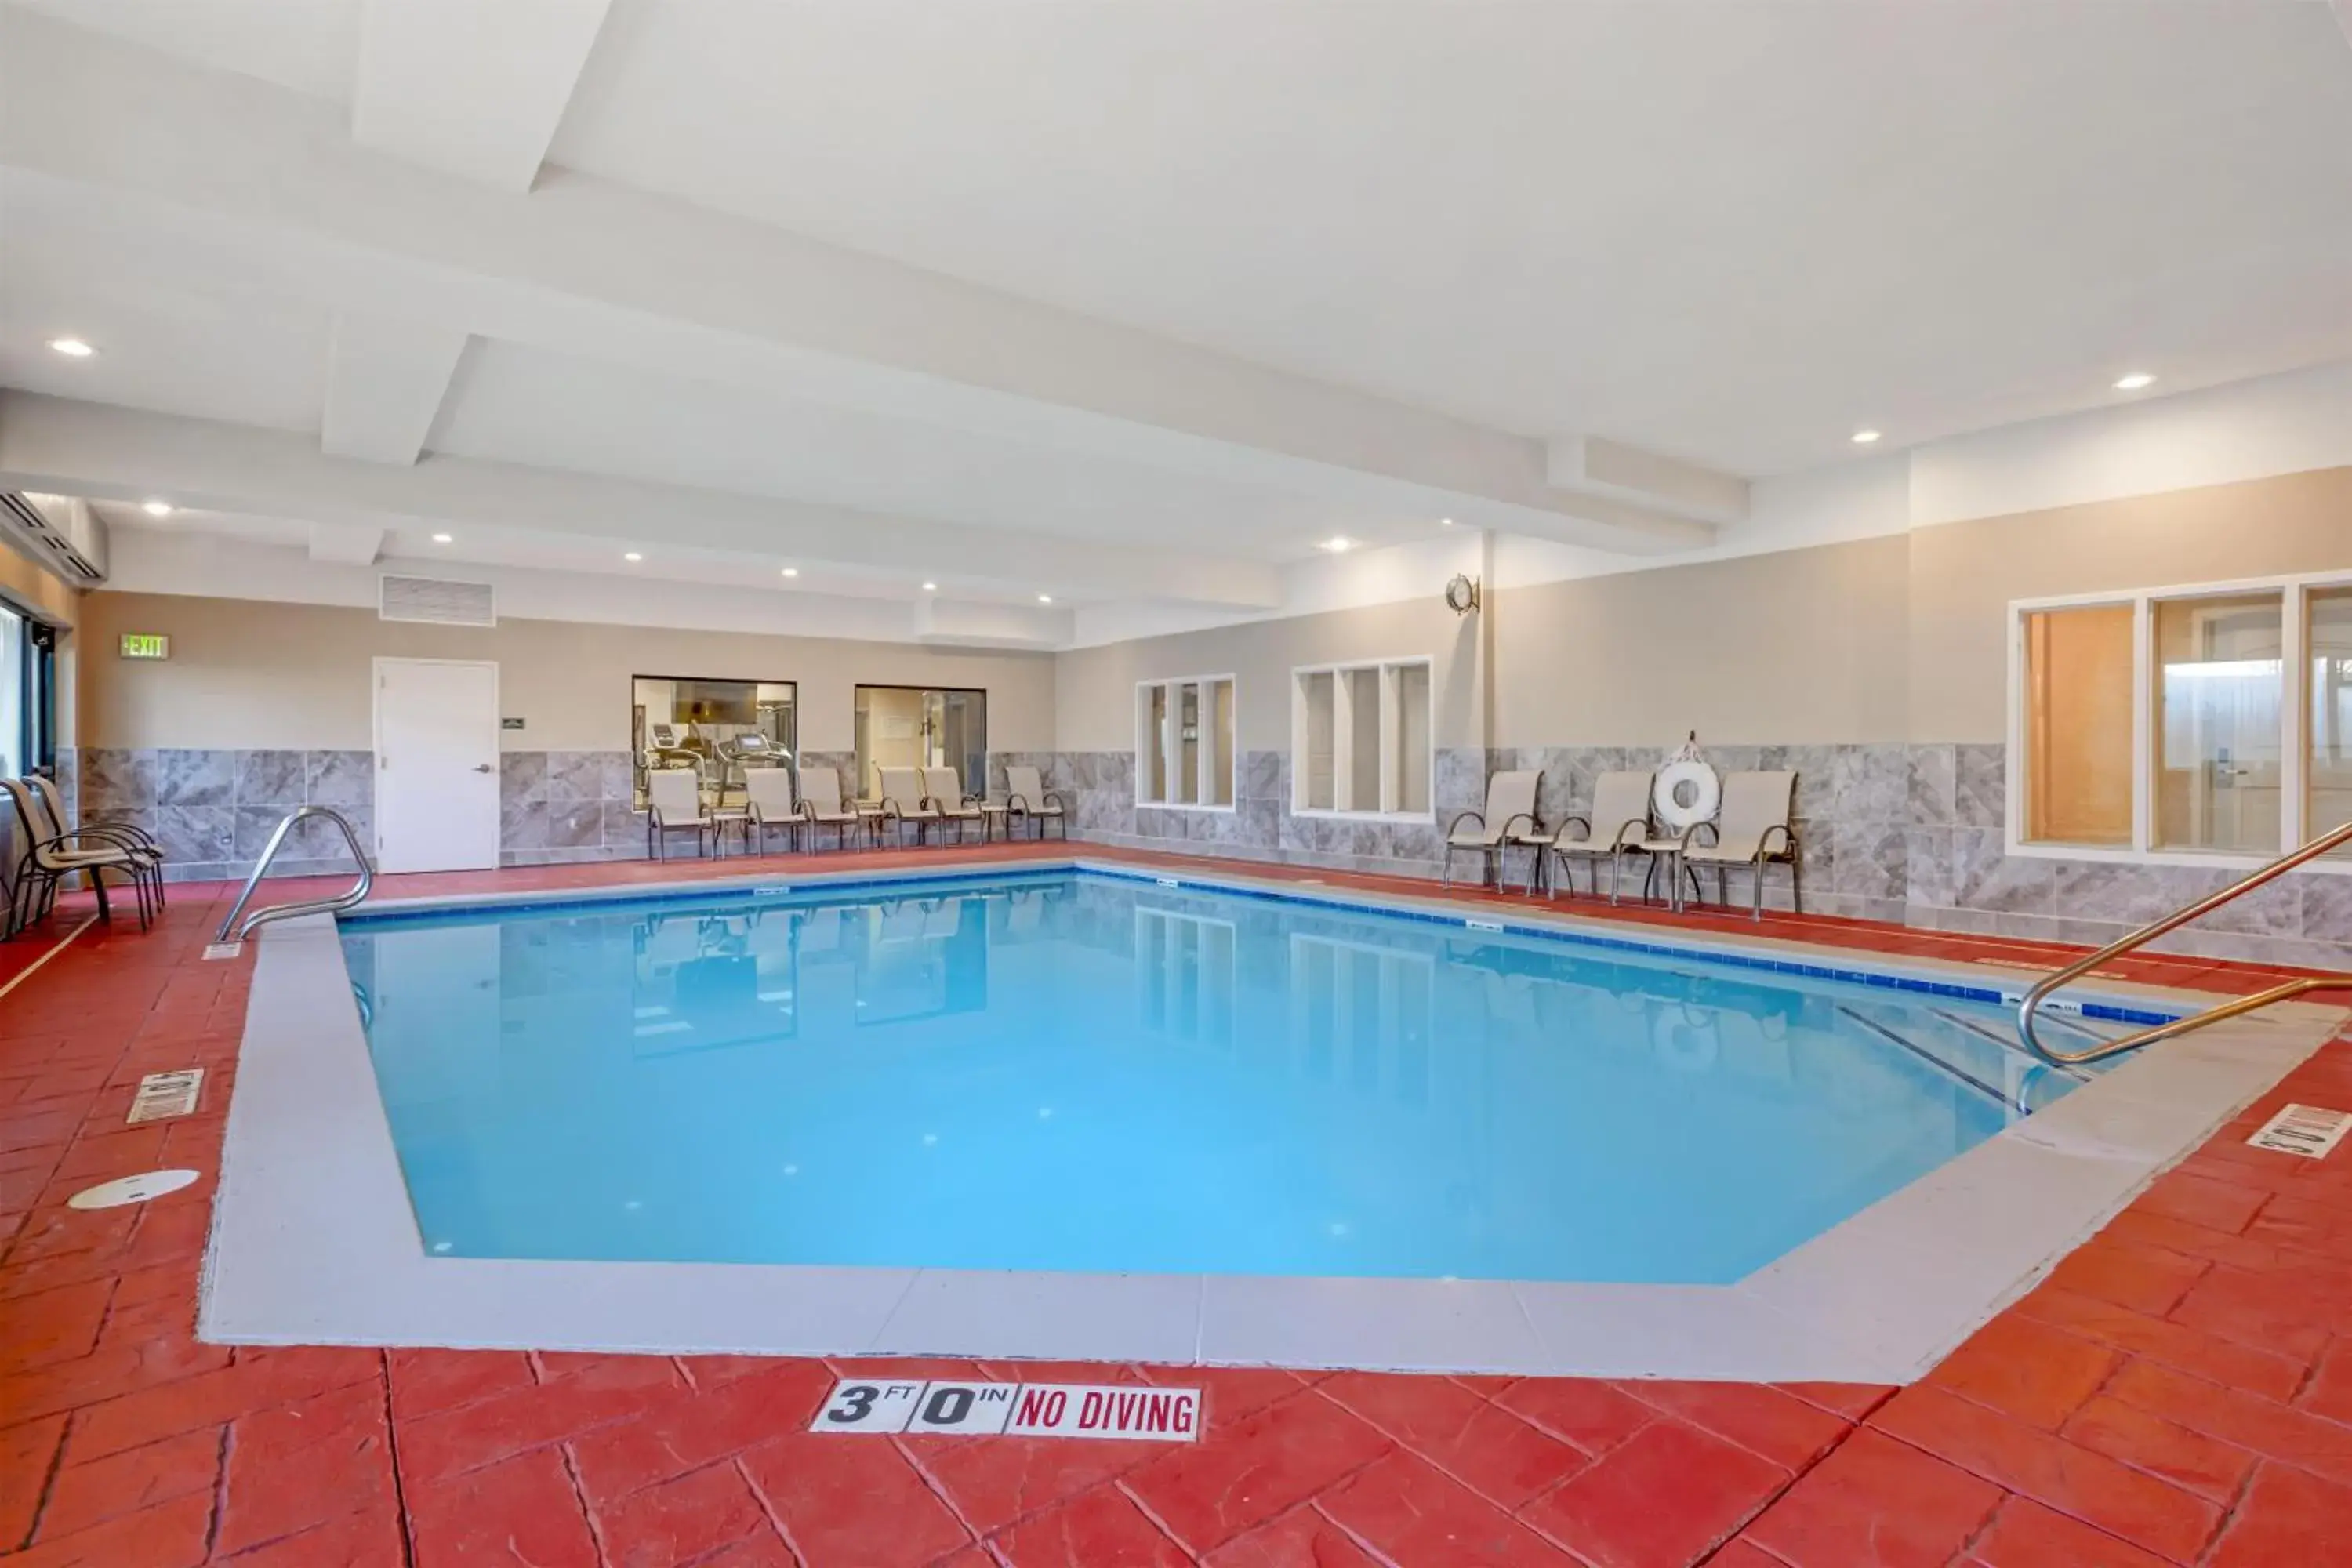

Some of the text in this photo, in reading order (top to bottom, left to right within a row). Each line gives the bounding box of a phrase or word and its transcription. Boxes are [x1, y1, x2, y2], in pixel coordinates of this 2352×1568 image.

[129, 636, 163, 656] EXIT
[827, 1385, 1193, 1432] 3 FT 0 IN NO DIVING
